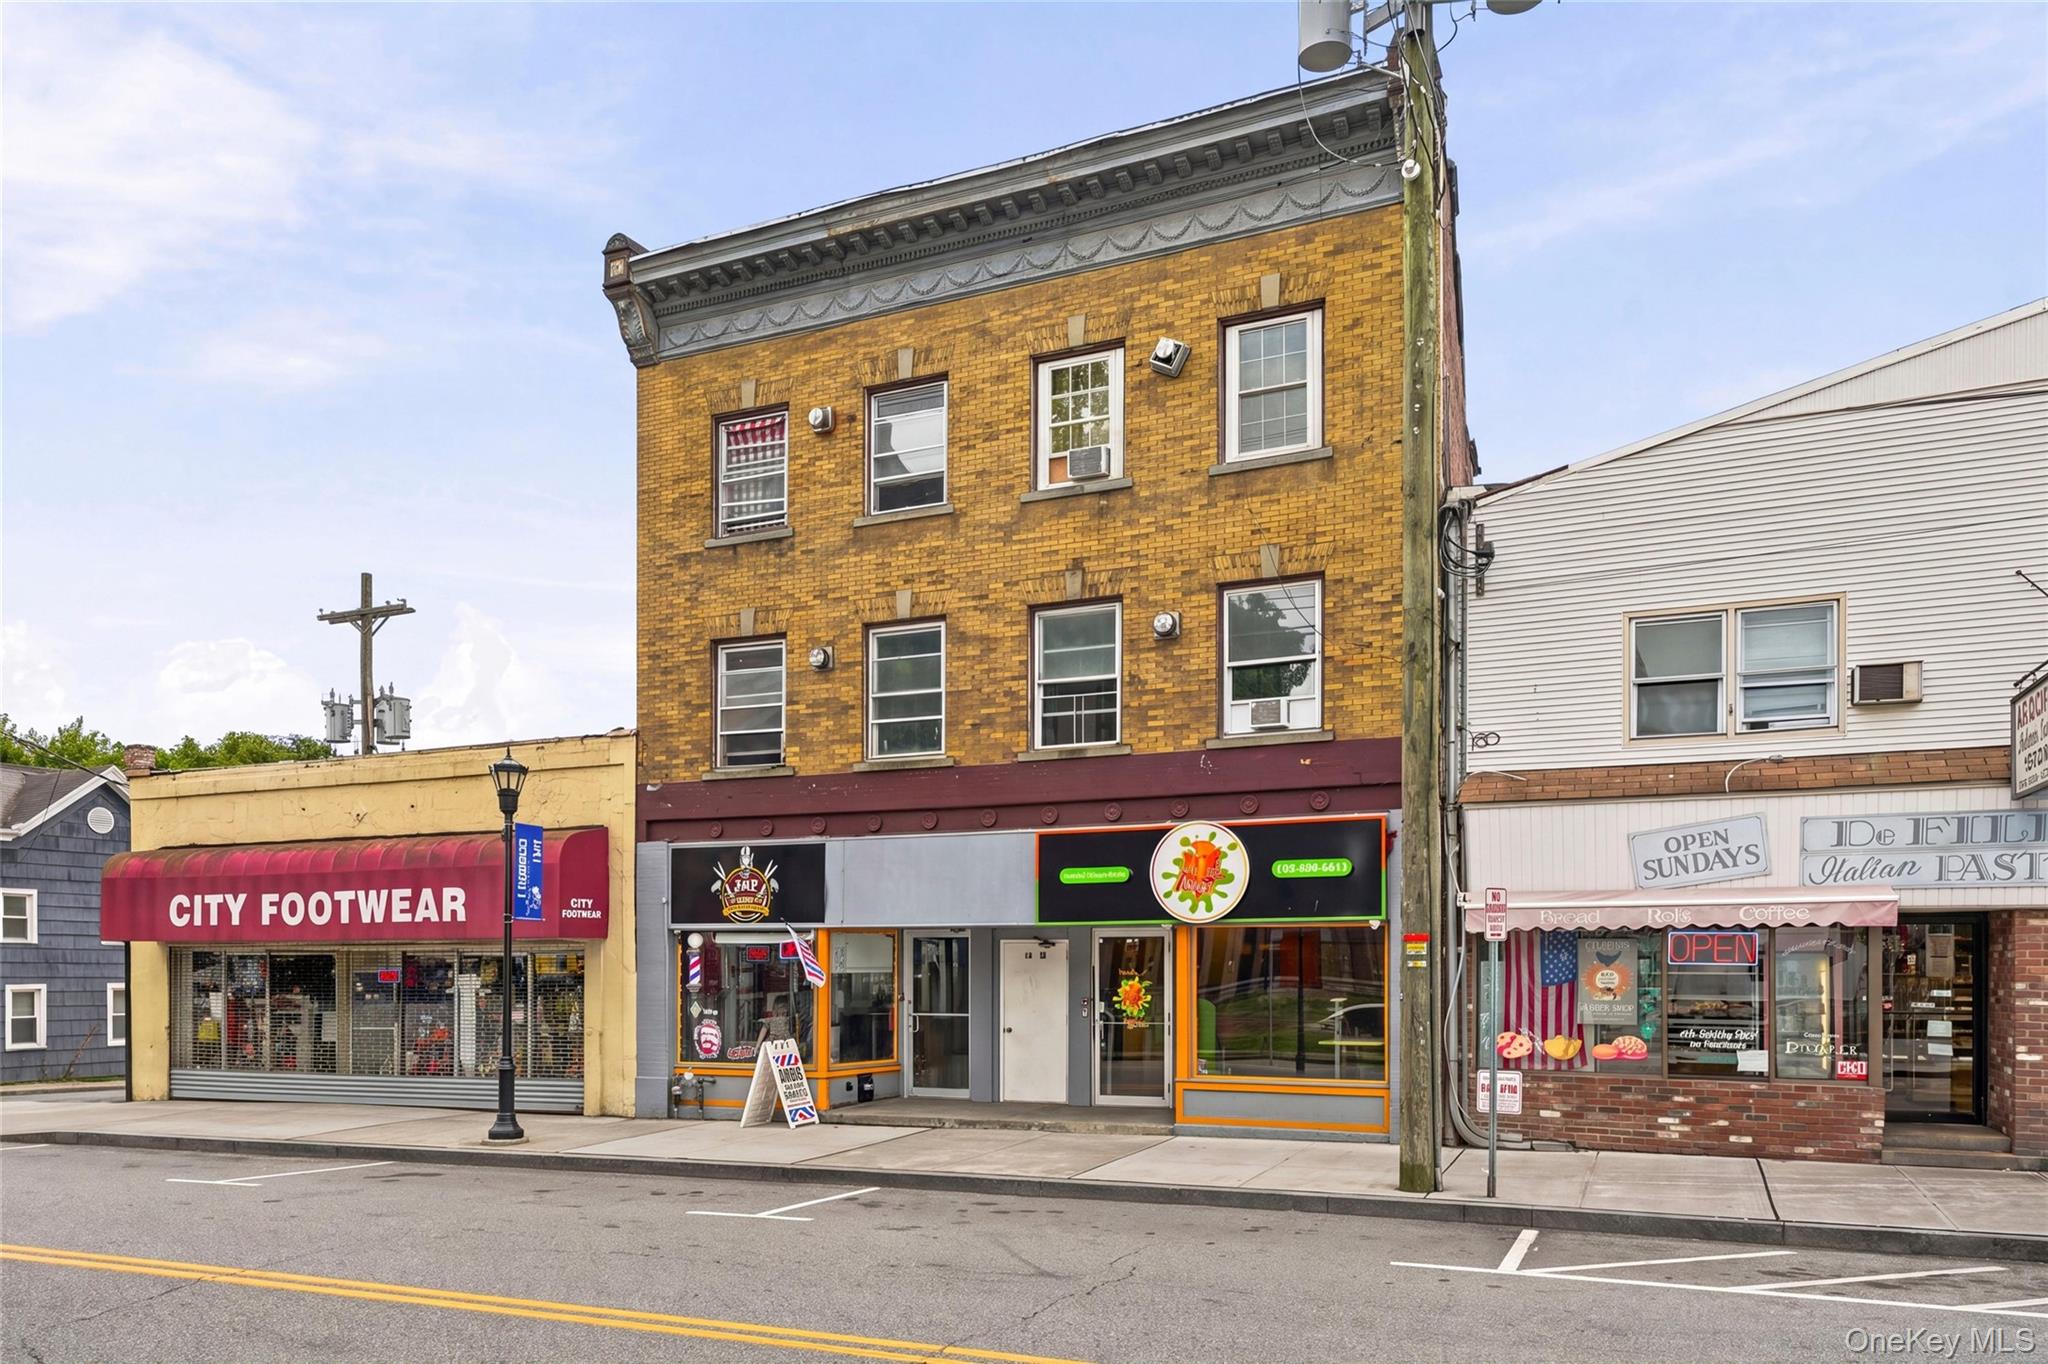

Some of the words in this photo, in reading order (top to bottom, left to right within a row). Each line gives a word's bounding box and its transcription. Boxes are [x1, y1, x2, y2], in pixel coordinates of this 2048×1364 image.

[1664, 829, 1729, 853] OPEN
[1830, 820, 1895, 847] De
[1643, 844, 1760, 880] SUNDAYS
[1808, 854, 1922, 885] Italian
[169, 893, 247, 927] CITY
[261, 887, 466, 926] FOOTWEAR
[570, 898, 593, 908] CITY
[1491, 891, 1501, 902] NO
[1540, 909, 1600, 925] Bread
[1739, 905, 1810, 921] Coffee
[1670, 934, 1756, 962] OPEN
